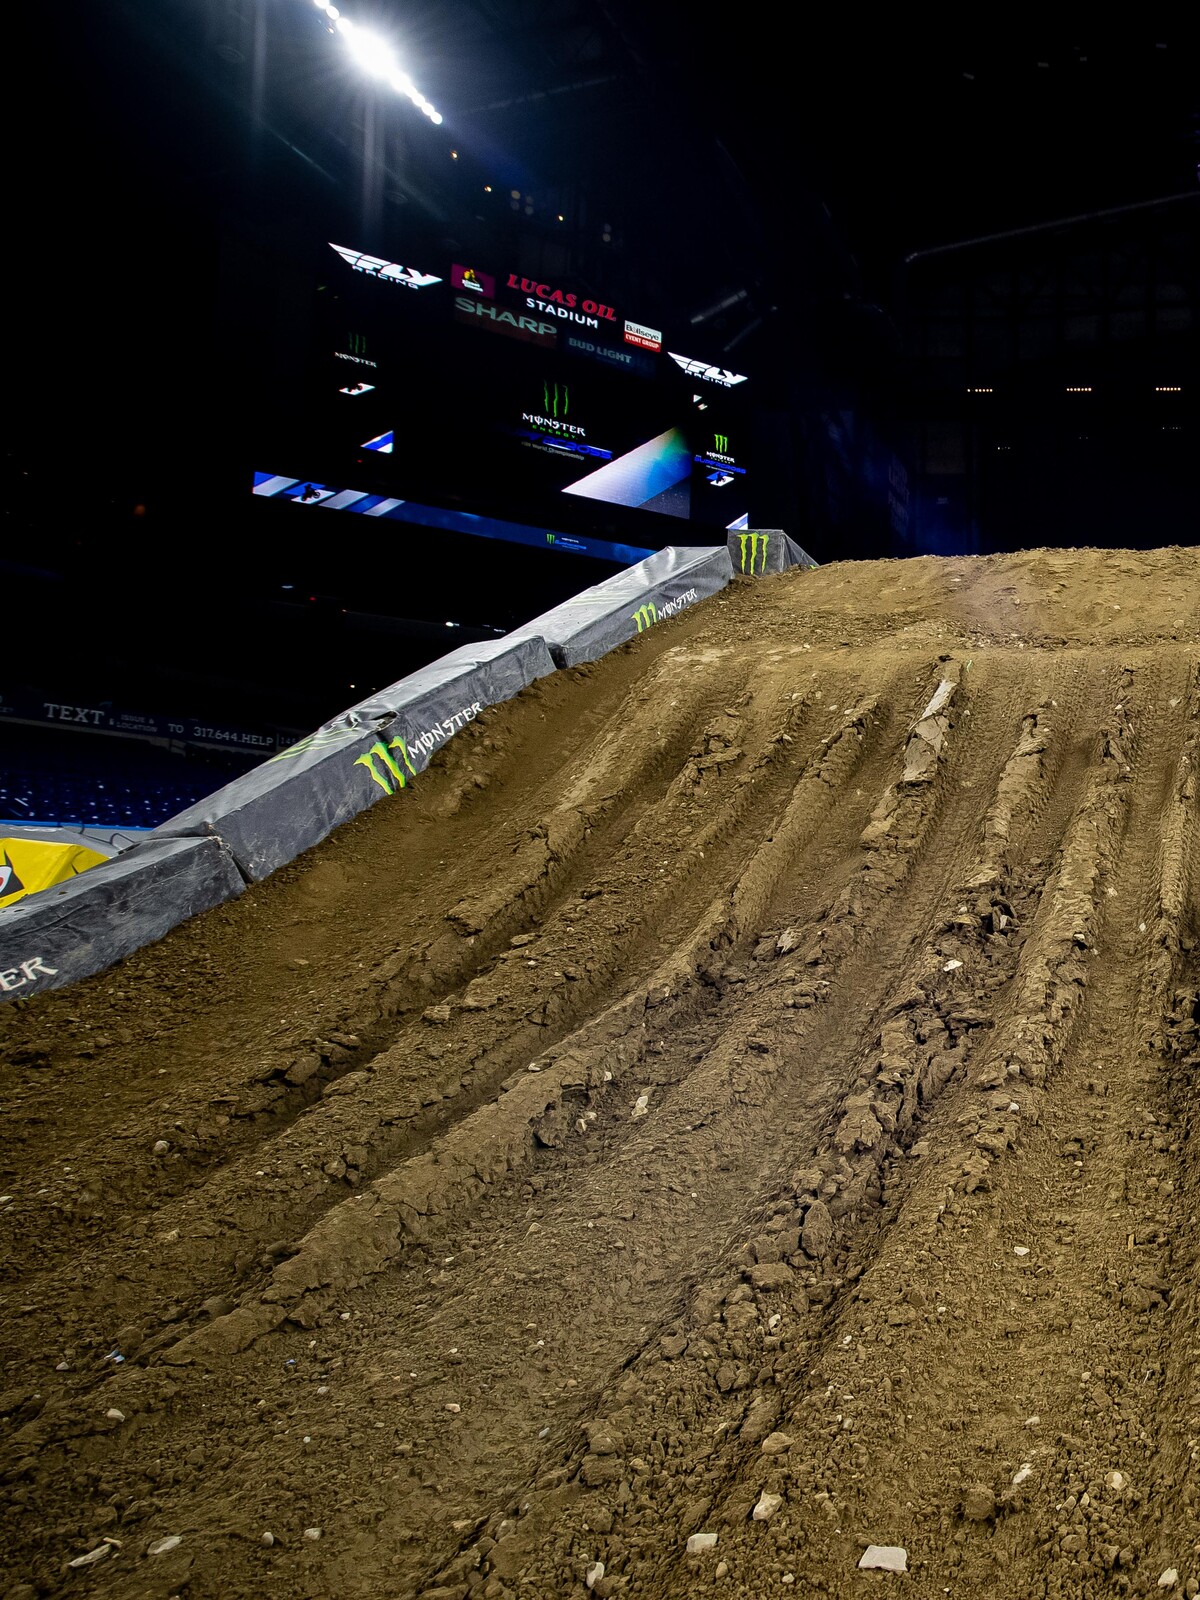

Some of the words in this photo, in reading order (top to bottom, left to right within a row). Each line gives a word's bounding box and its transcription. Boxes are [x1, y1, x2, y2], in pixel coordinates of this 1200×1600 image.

[352, 264, 419, 290] RACING
[507, 273, 577, 307] LUCAS
[582, 299, 617, 322] OIL
[455, 296, 557, 335] SHARP
[526, 297, 599, 329] STADIUM
[568, 337, 595, 352] BUD
[596, 345, 633, 364] LIGHT
[522, 413, 586, 437] MONSTER
[532, 425, 577, 439] ENERGY
[657, 588, 698, 620] MONSTER
[43, 703, 105, 725] TEXT
[168, 723, 185, 733] TO
[407, 702, 483, 759] MONSTER
